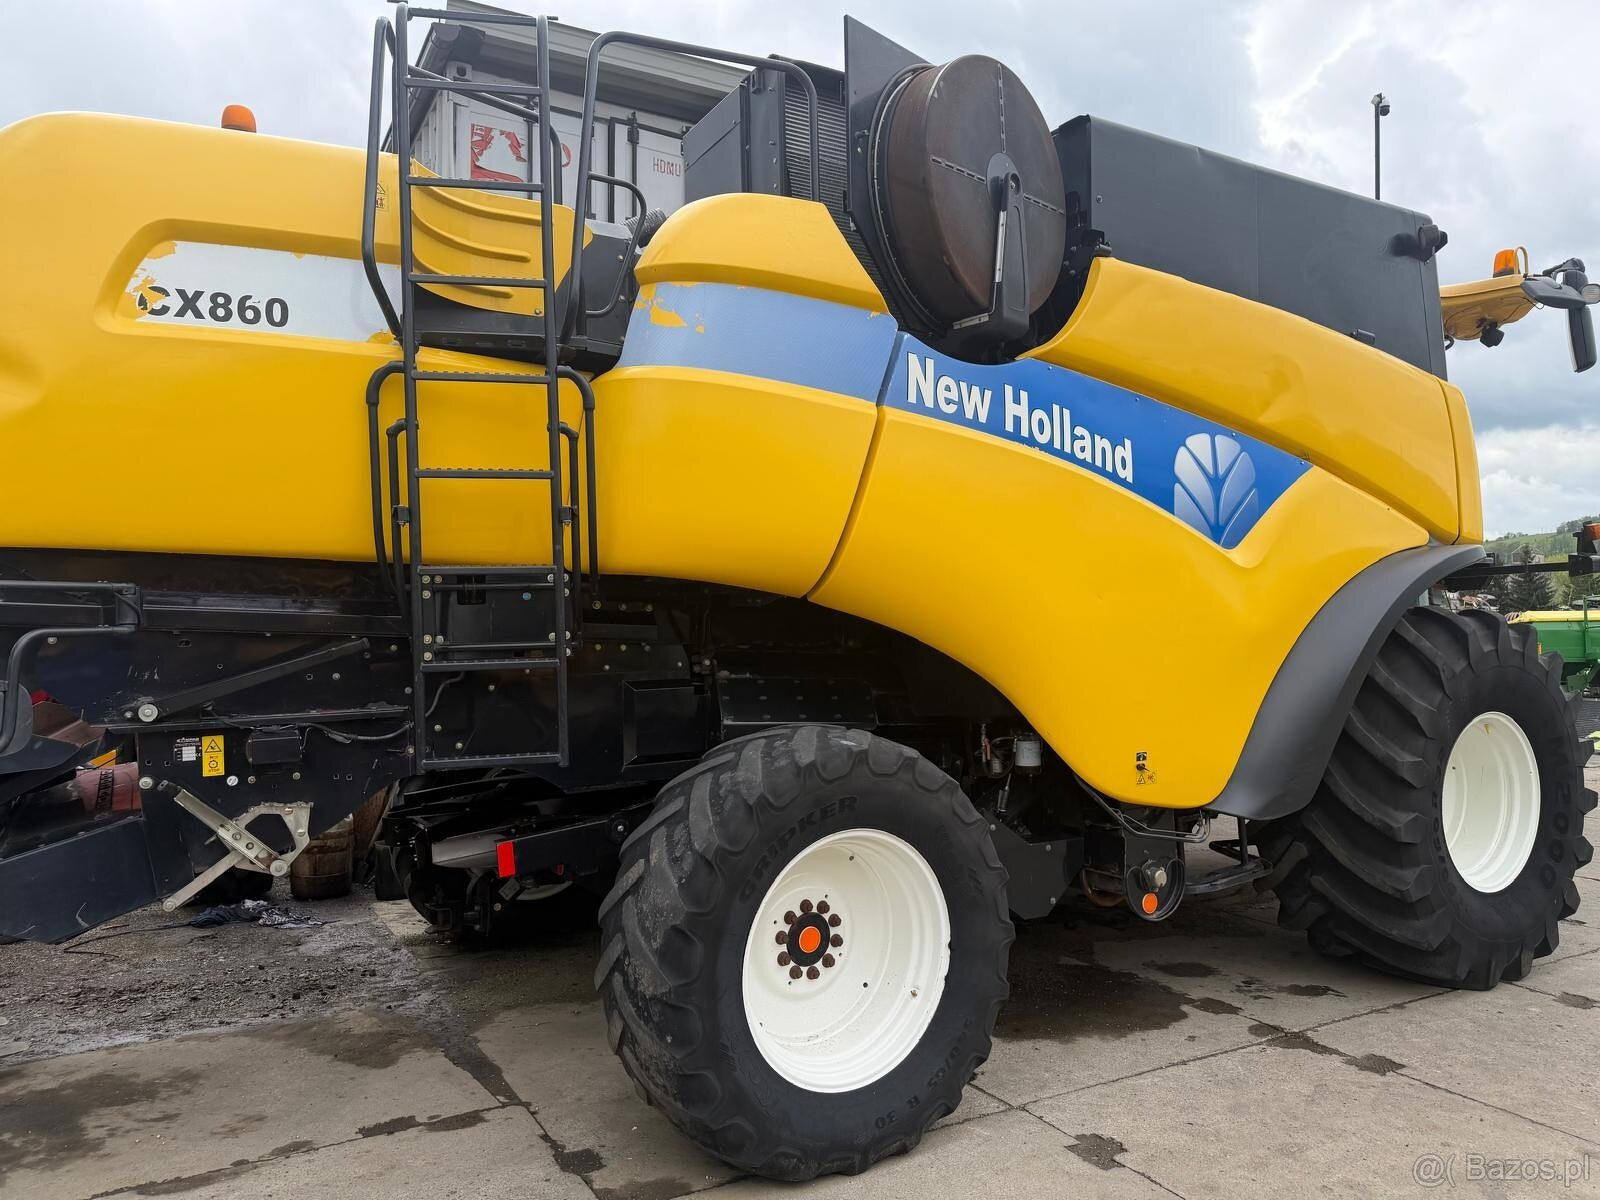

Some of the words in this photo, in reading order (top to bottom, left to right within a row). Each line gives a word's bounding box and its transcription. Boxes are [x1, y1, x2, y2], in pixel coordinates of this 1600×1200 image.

[652, 157, 682, 177] HDMU
[138, 285, 290, 328] CX860
[906, 352, 993, 424] New
[1004, 383, 1134, 484] Holland
